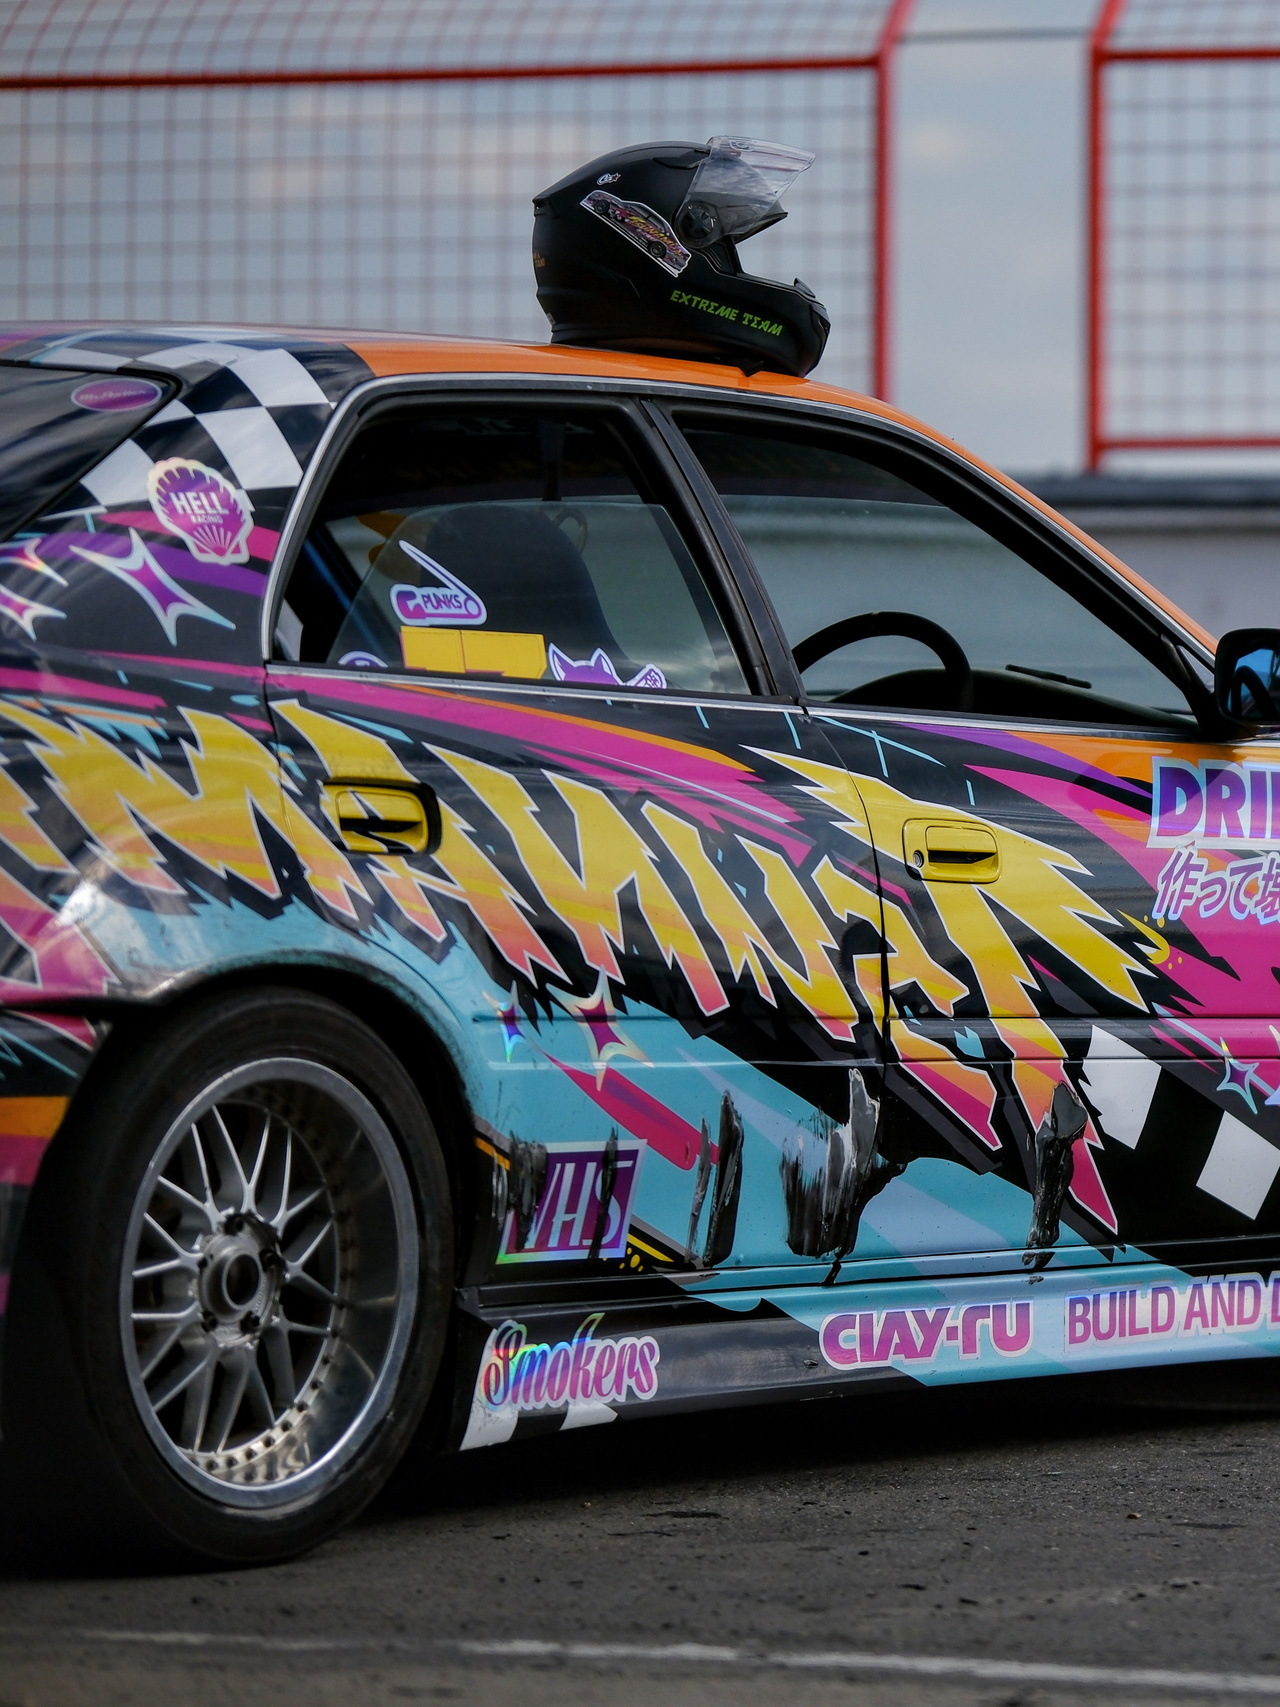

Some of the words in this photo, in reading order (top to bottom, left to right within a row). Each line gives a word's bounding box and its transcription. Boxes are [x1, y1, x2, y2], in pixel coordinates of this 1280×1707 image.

[670, 290, 739, 321] EXTREME
[742, 313, 783, 336] TEAM
[169, 491, 230, 514] HELL
[1068, 1285, 1176, 1345] BUILD
[1183, 1279, 1262, 1331] AND
[484, 1312, 657, 1406] Smokers
